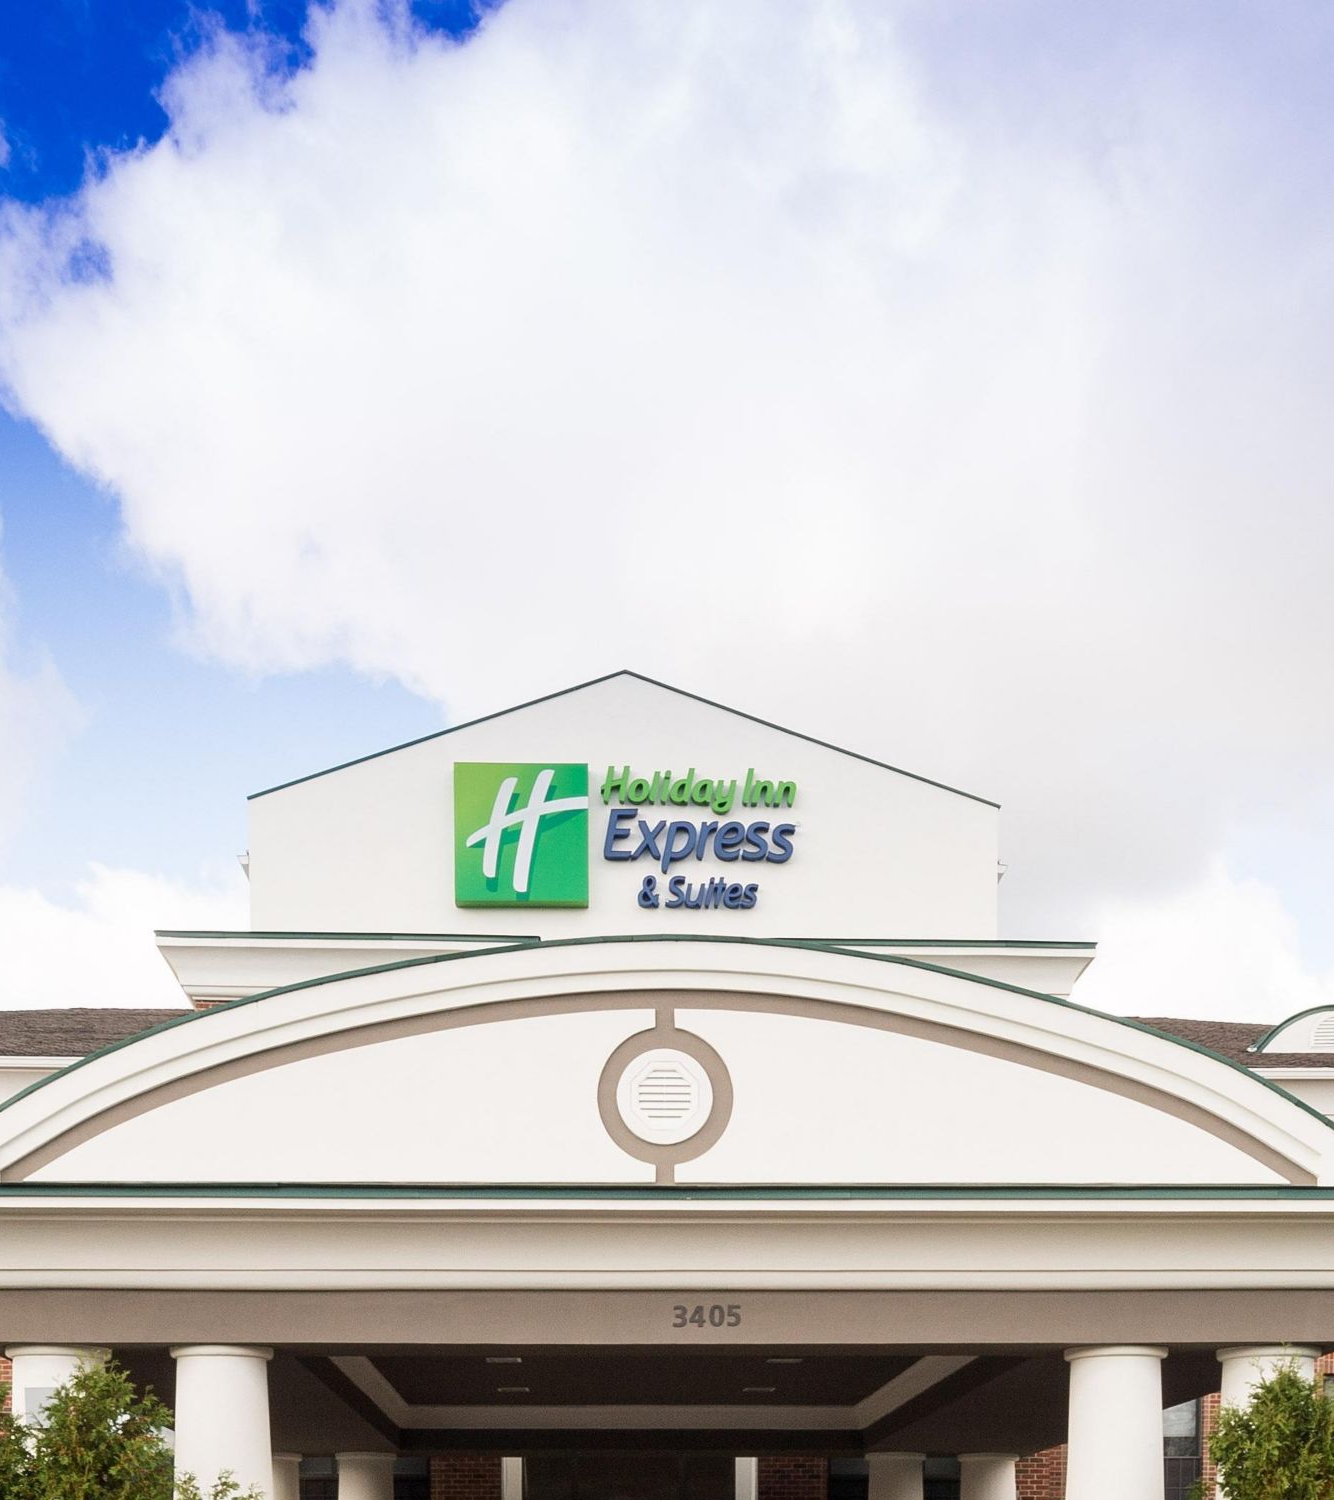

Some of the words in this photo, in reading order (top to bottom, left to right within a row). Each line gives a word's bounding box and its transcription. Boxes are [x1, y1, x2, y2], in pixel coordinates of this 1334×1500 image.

[600, 765, 735, 815] Holiday
[742, 767, 797, 808] Inn
[603, 808, 796, 874] Express
[637, 875, 659, 909] &
[665, 875, 759, 910] Suites
[672, 1304, 742, 1328] 3405
